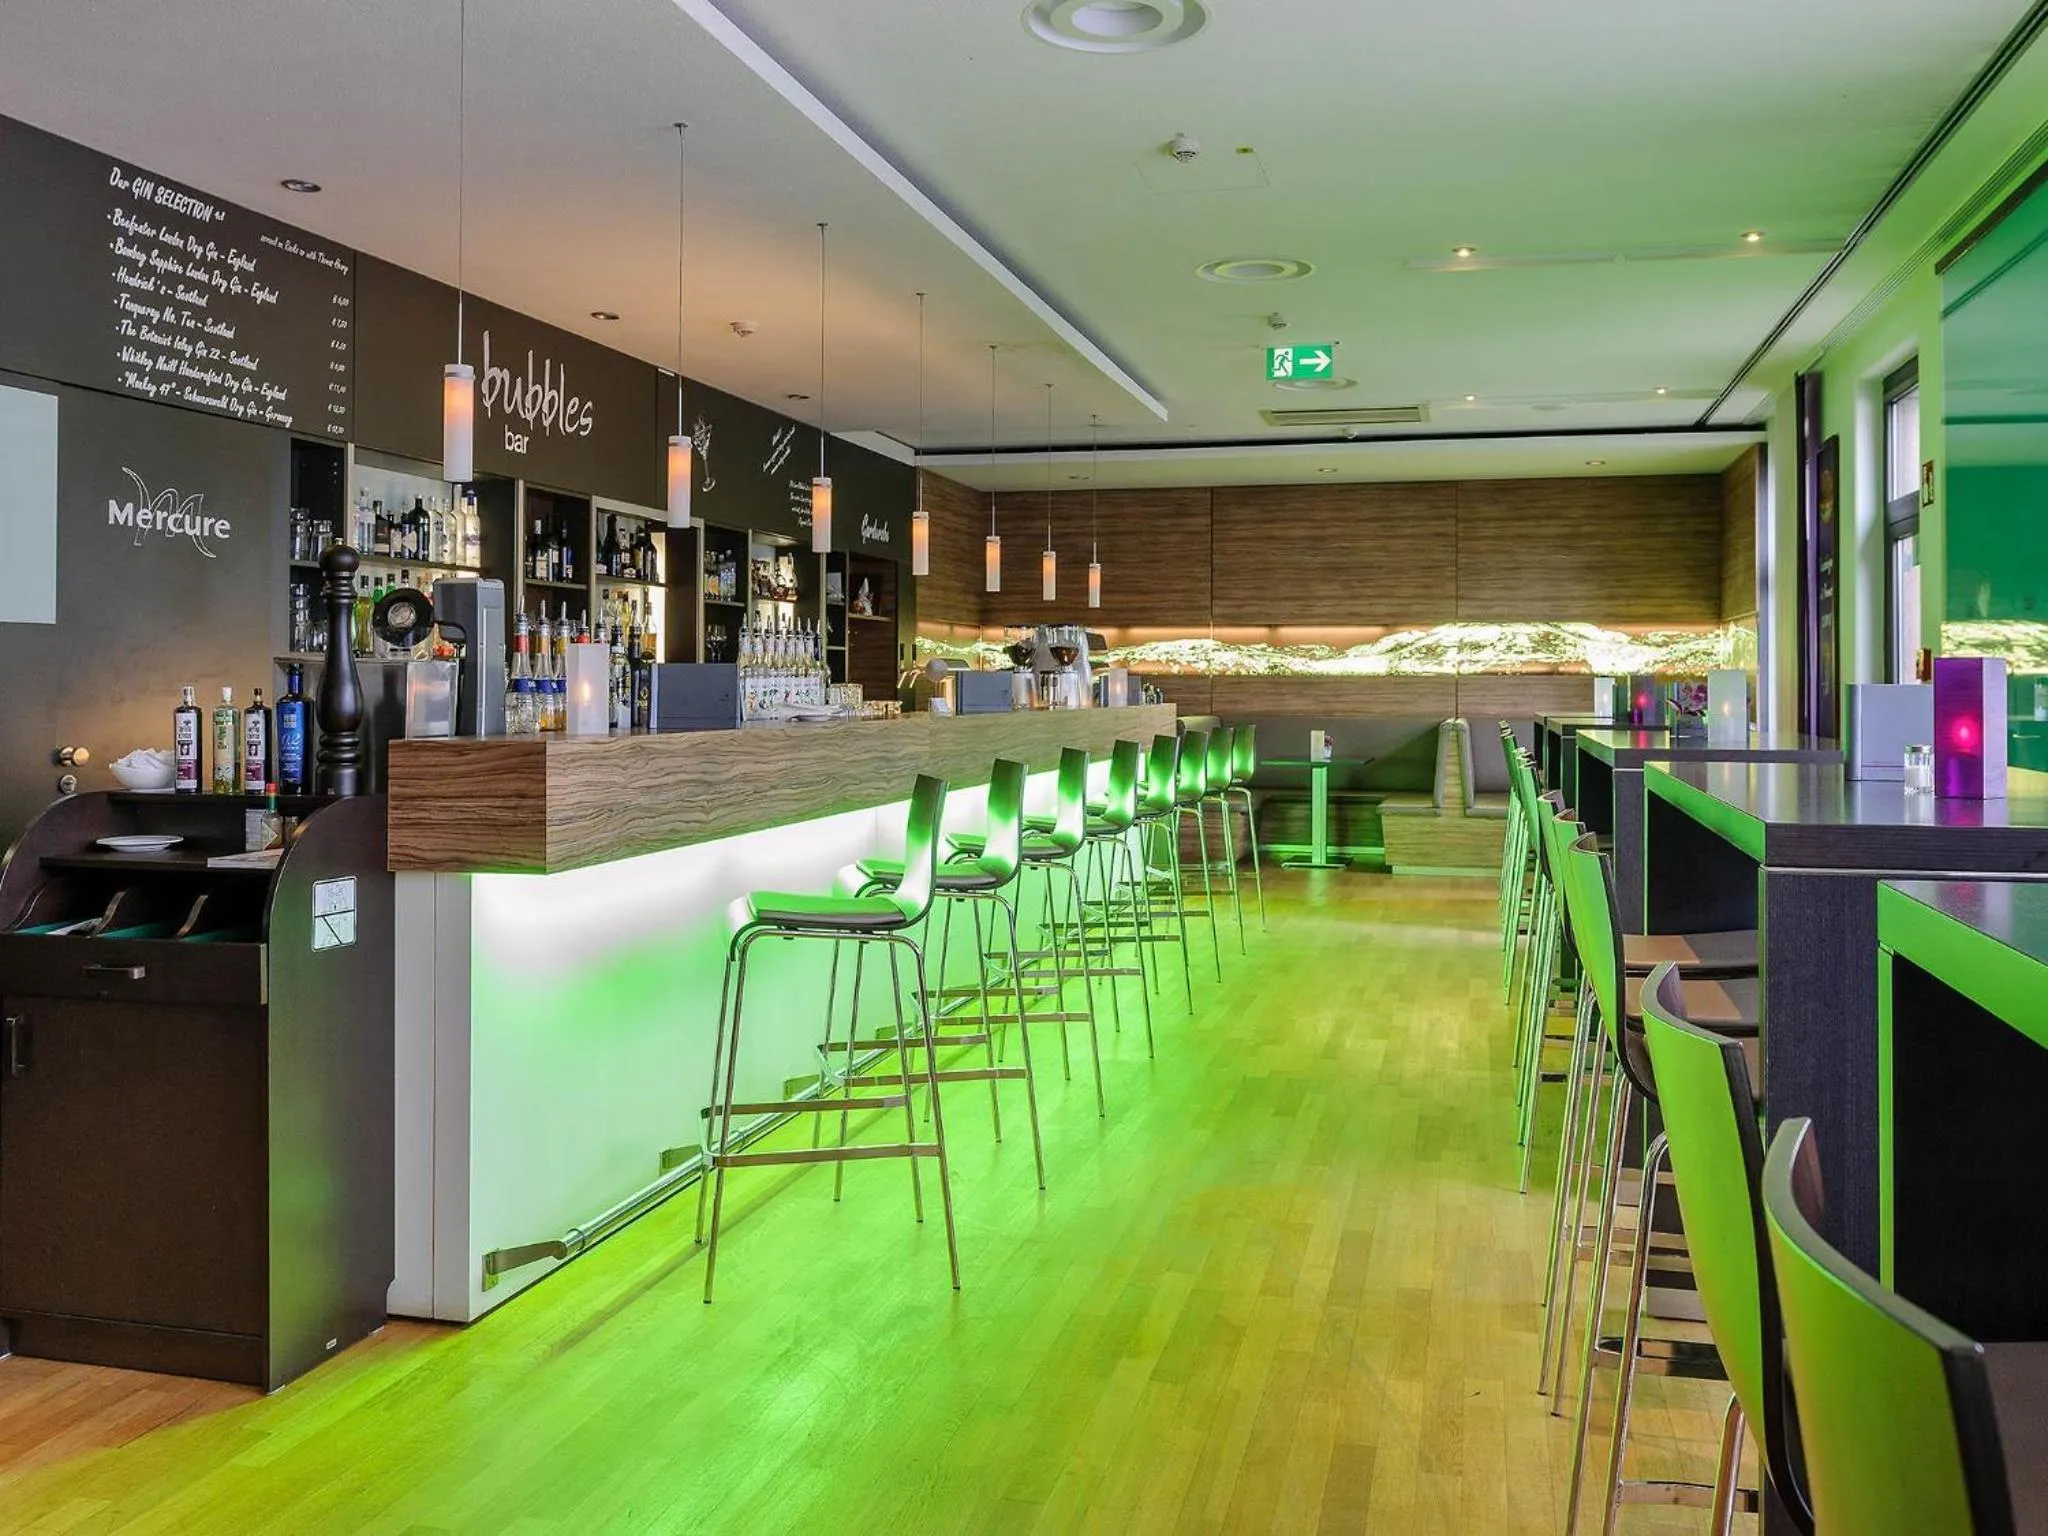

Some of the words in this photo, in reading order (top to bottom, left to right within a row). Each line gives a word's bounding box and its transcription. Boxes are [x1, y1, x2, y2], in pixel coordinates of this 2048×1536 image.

[132, 177, 154, 200] GIN
[154, 186, 214, 223] SELECTION
[115, 237, 146, 267] Bombay
[150, 249, 183, 274] Sapphire
[185, 262, 209, 283] London
[211, 270, 228, 293] Dry
[230, 276, 242, 295] Gin
[251, 282, 279, 305] England
[159, 226, 184, 249] London
[187, 235, 203, 260] Dry
[206, 242, 218, 261] Gin
[228, 249, 256, 272] England
[120, 293, 160, 324] Tanqueray
[181, 311, 196, 328] Ten
[204, 317, 236, 339] Scotland
[175, 284, 209, 307] Scotland
[120, 319, 137, 336] The
[139, 324, 172, 346] Botanist
[195, 341, 208, 359] Gin
[209, 348, 221, 360] 22
[228, 350, 259, 371] Scotland
[122, 345, 154, 372] Whitley
[224, 373, 240, 394] Dry
[241, 377, 253, 395] Gin
[260, 382, 288, 402] England
[481, 330, 593, 436] bubbles
[229, 397, 244, 417] Dry
[246, 401, 258, 418] Gin
[265, 405, 293, 428] Germany
[505, 424, 529, 454] bar
[108, 499, 231, 539] Mercure
